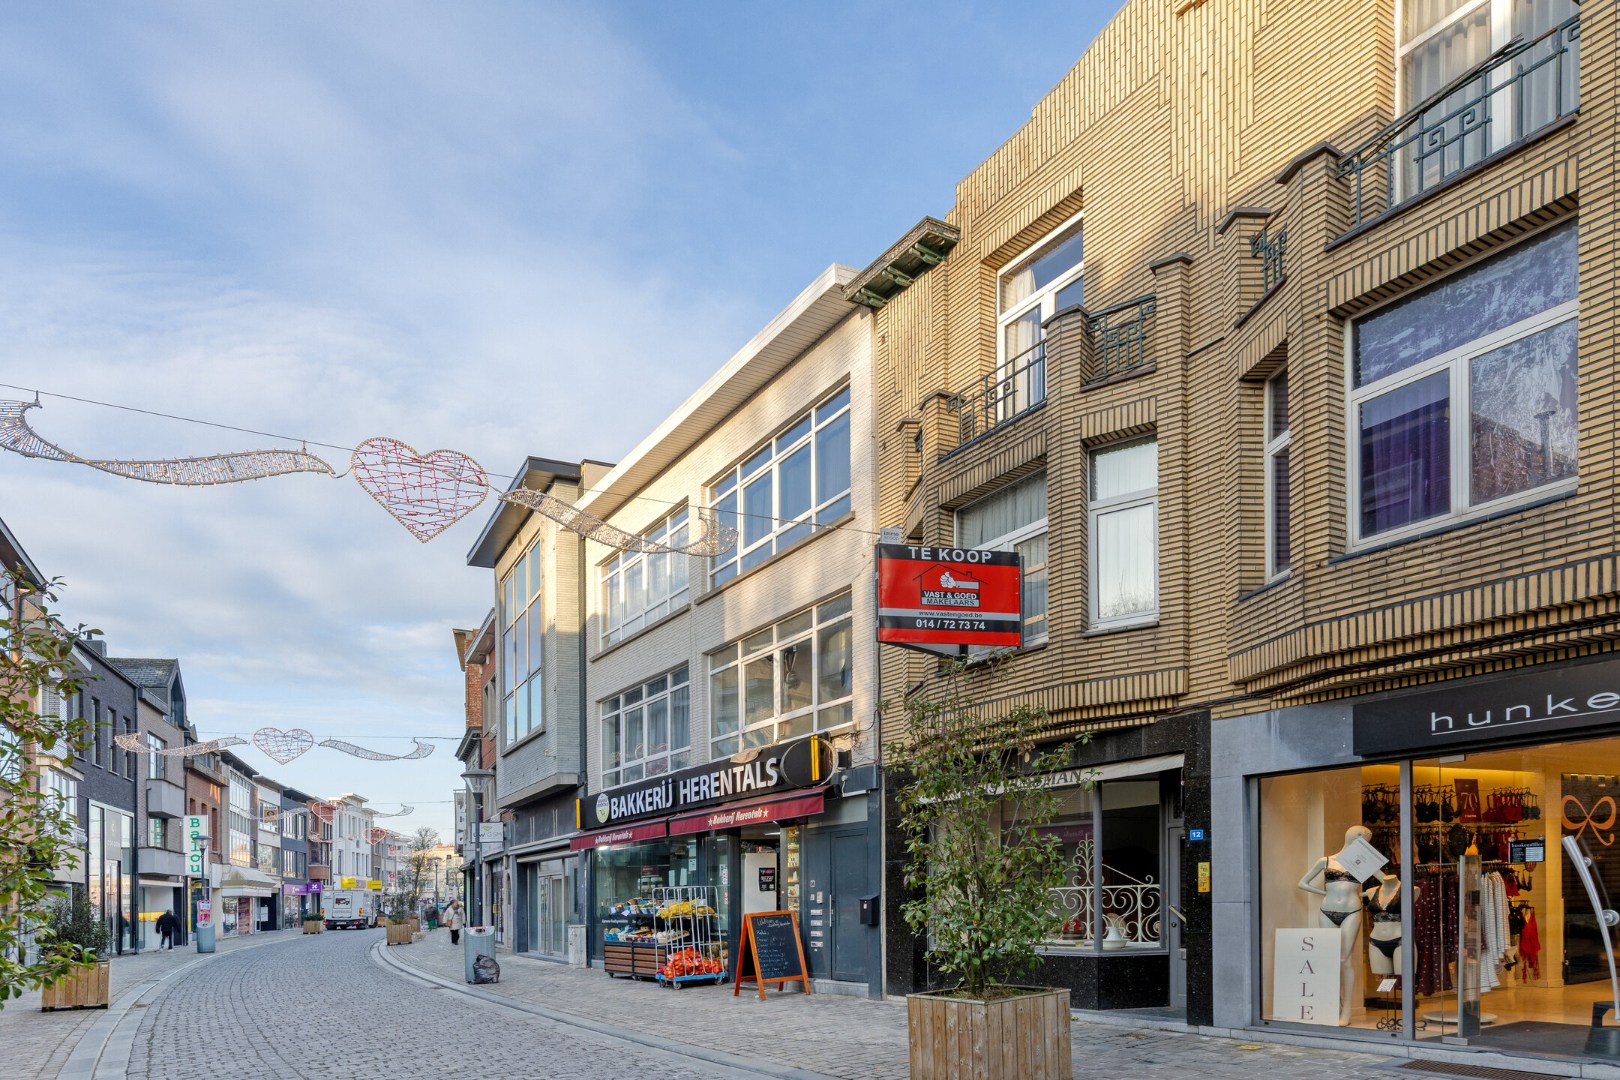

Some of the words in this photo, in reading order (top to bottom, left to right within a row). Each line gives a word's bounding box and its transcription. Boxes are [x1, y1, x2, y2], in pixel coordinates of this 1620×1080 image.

[908, 546, 932, 560] TE
[938, 549, 992, 564] KOOP
[923, 591, 945, 599] VAST
[954, 592, 977, 600] GOED
[926, 598, 975, 607] MAKELAARS
[918, 610, 983, 619] www.vastengoed.be
[916, 619, 935, 629] 014
[936, 619, 941, 629] /
[943, 620, 956, 629] 72
[958, 620, 971, 630] 73
[973, 620, 986, 630] 74
[1431, 692, 1620, 732] hunke
[679, 757, 778, 805] HERENTALS
[712, 812, 736, 825] Bakkerij
[735, 807, 763, 821] Herentals
[189, 817, 201, 873] Balou
[1299, 936, 1316, 1021] SALE
